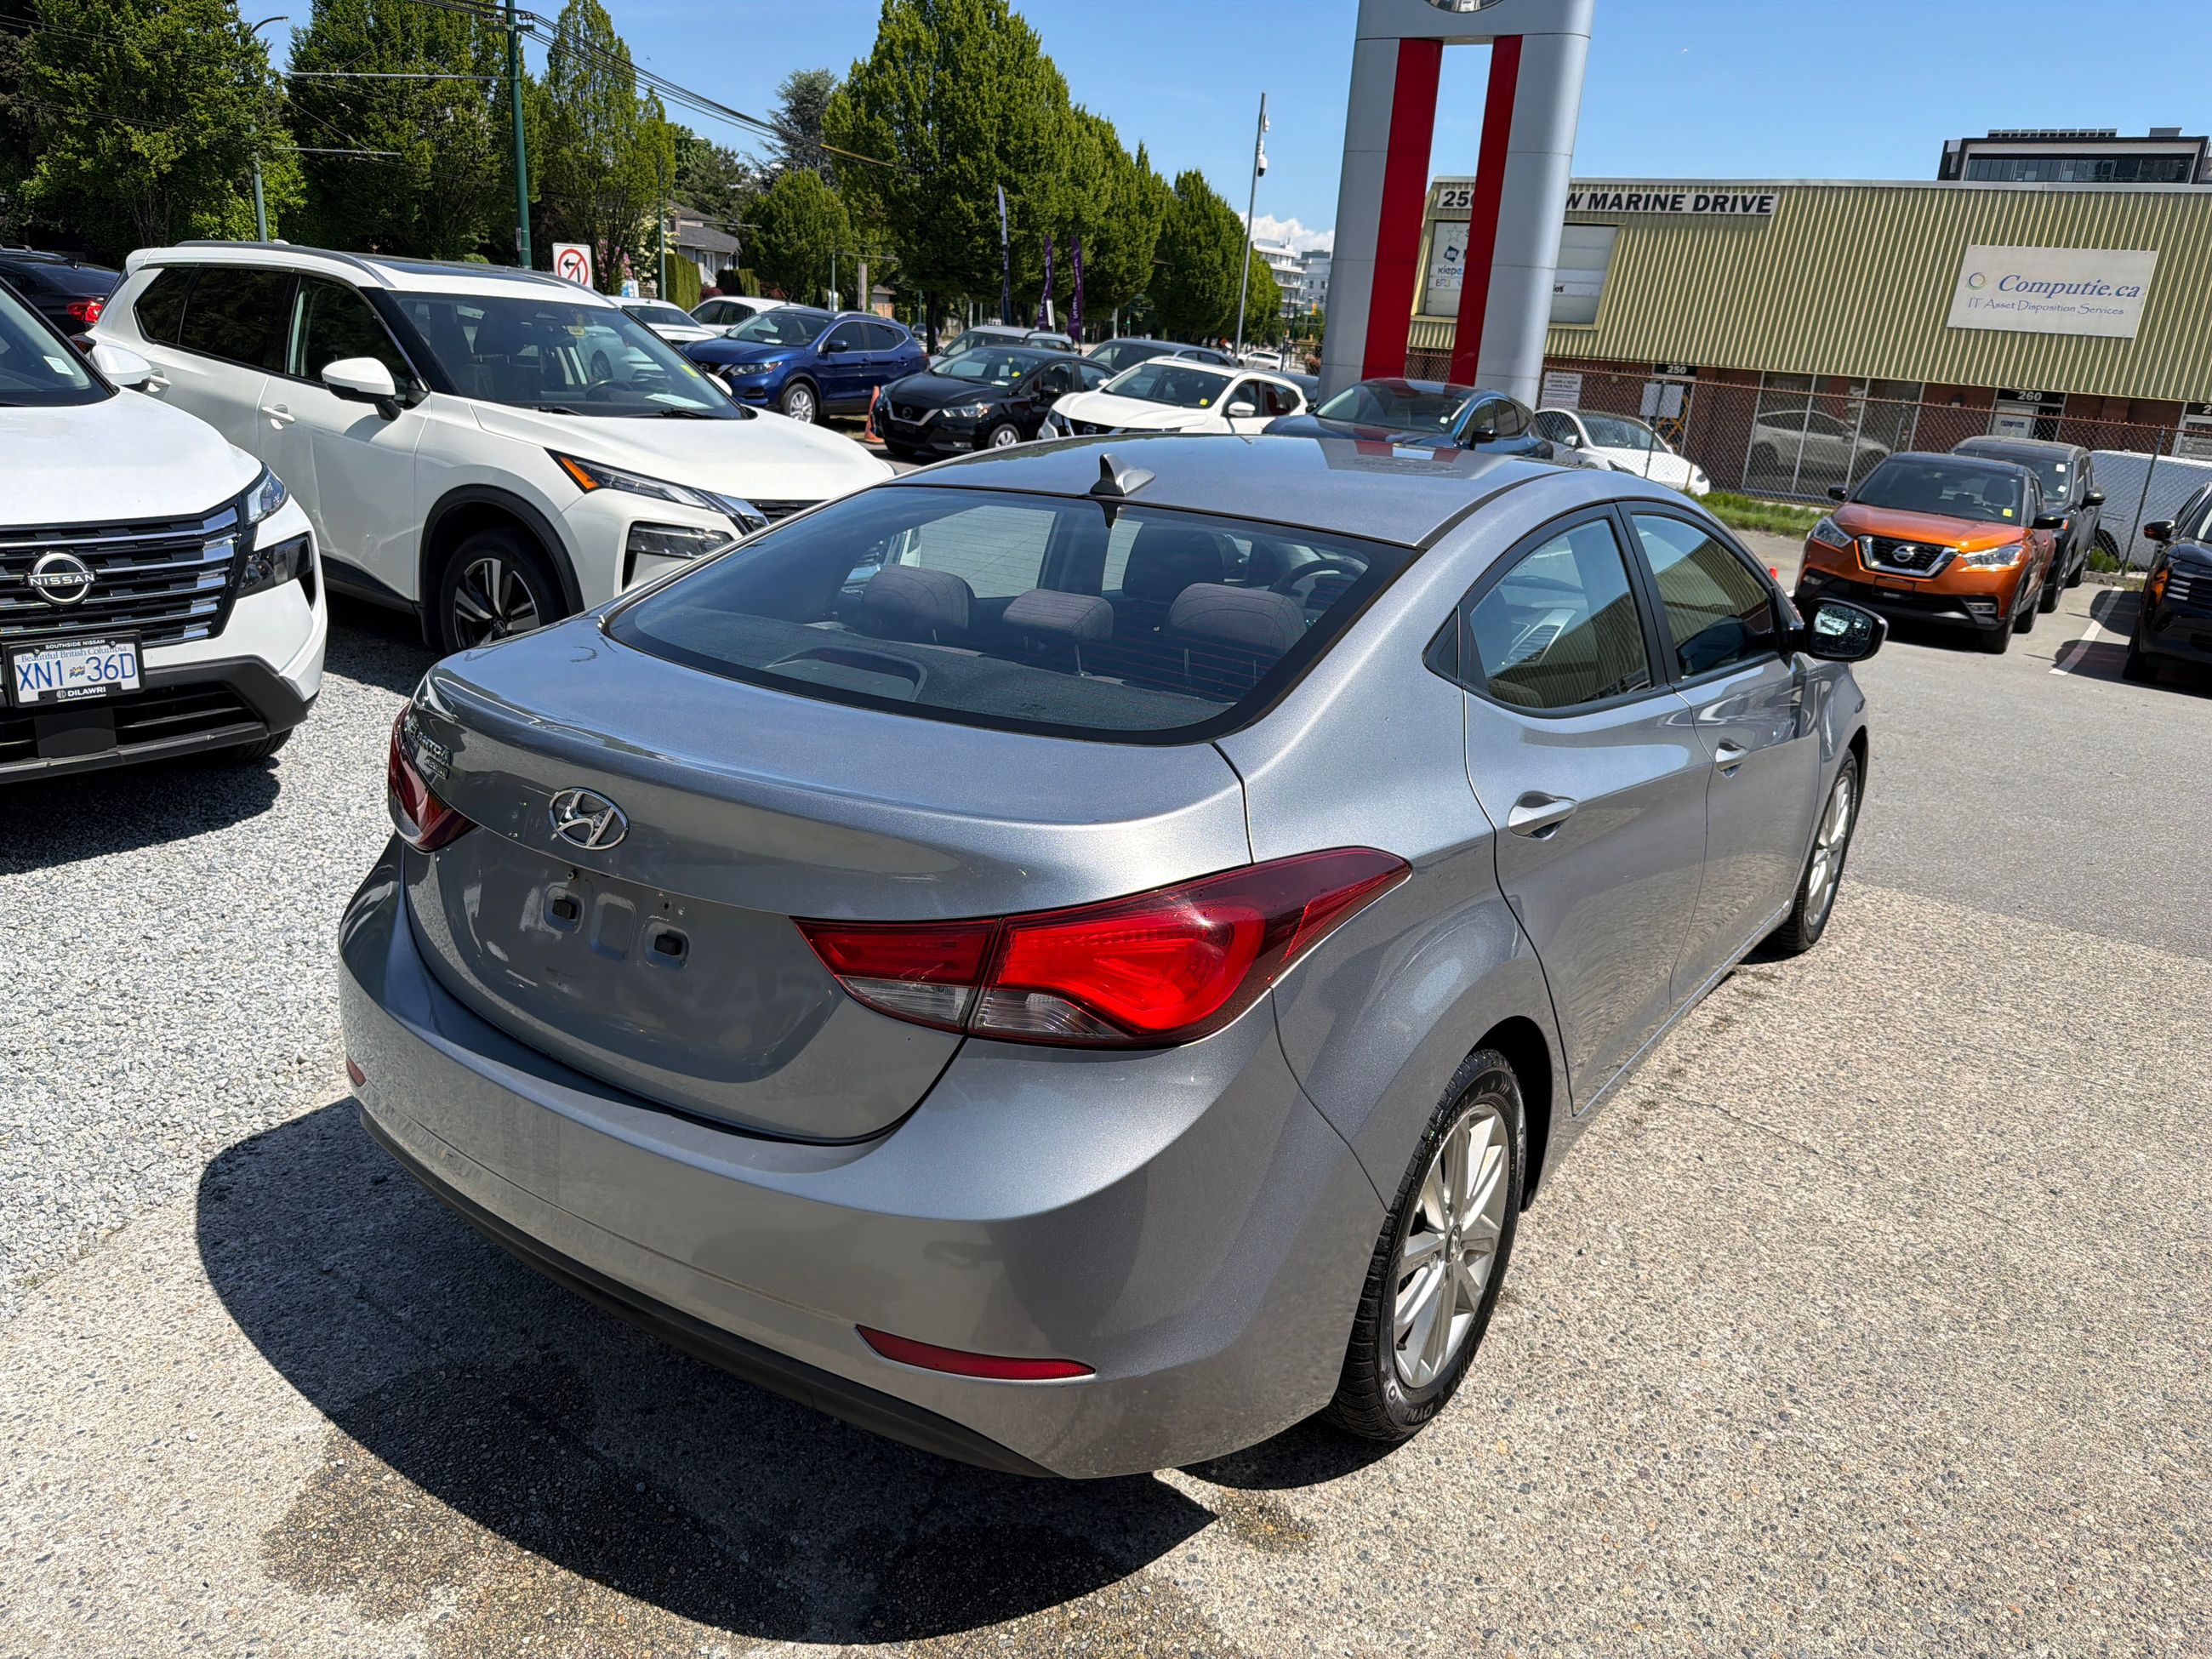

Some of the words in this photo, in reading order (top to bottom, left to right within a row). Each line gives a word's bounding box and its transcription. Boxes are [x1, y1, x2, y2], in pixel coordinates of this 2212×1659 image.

[1442, 190, 1475, 208] 25
[1587, 192, 1686, 211] MARINE
[1692, 194, 1775, 214] DRIVE
[1998, 274, 2141, 298] Computie.ca
[1967, 297, 1983, 309] IT
[1983, 298, 2015, 310] Asset
[2017, 299, 2076, 314] Disposition
[2078, 303, 2124, 315] Services
[1668, 366, 1686, 374] 250
[2017, 391, 2042, 402] 260
[30, 573, 94, 585] NISSAN
[45, 641, 82, 650] SOUTHSIDE
[21, 651, 59, 663] Beautiful
[60, 647, 87, 658] British
[88, 645, 127, 655] Columbia
[16, 659, 64, 691] XN1
[86, 653, 136, 682] 36D
[67, 686, 106, 697] DILAWRI
